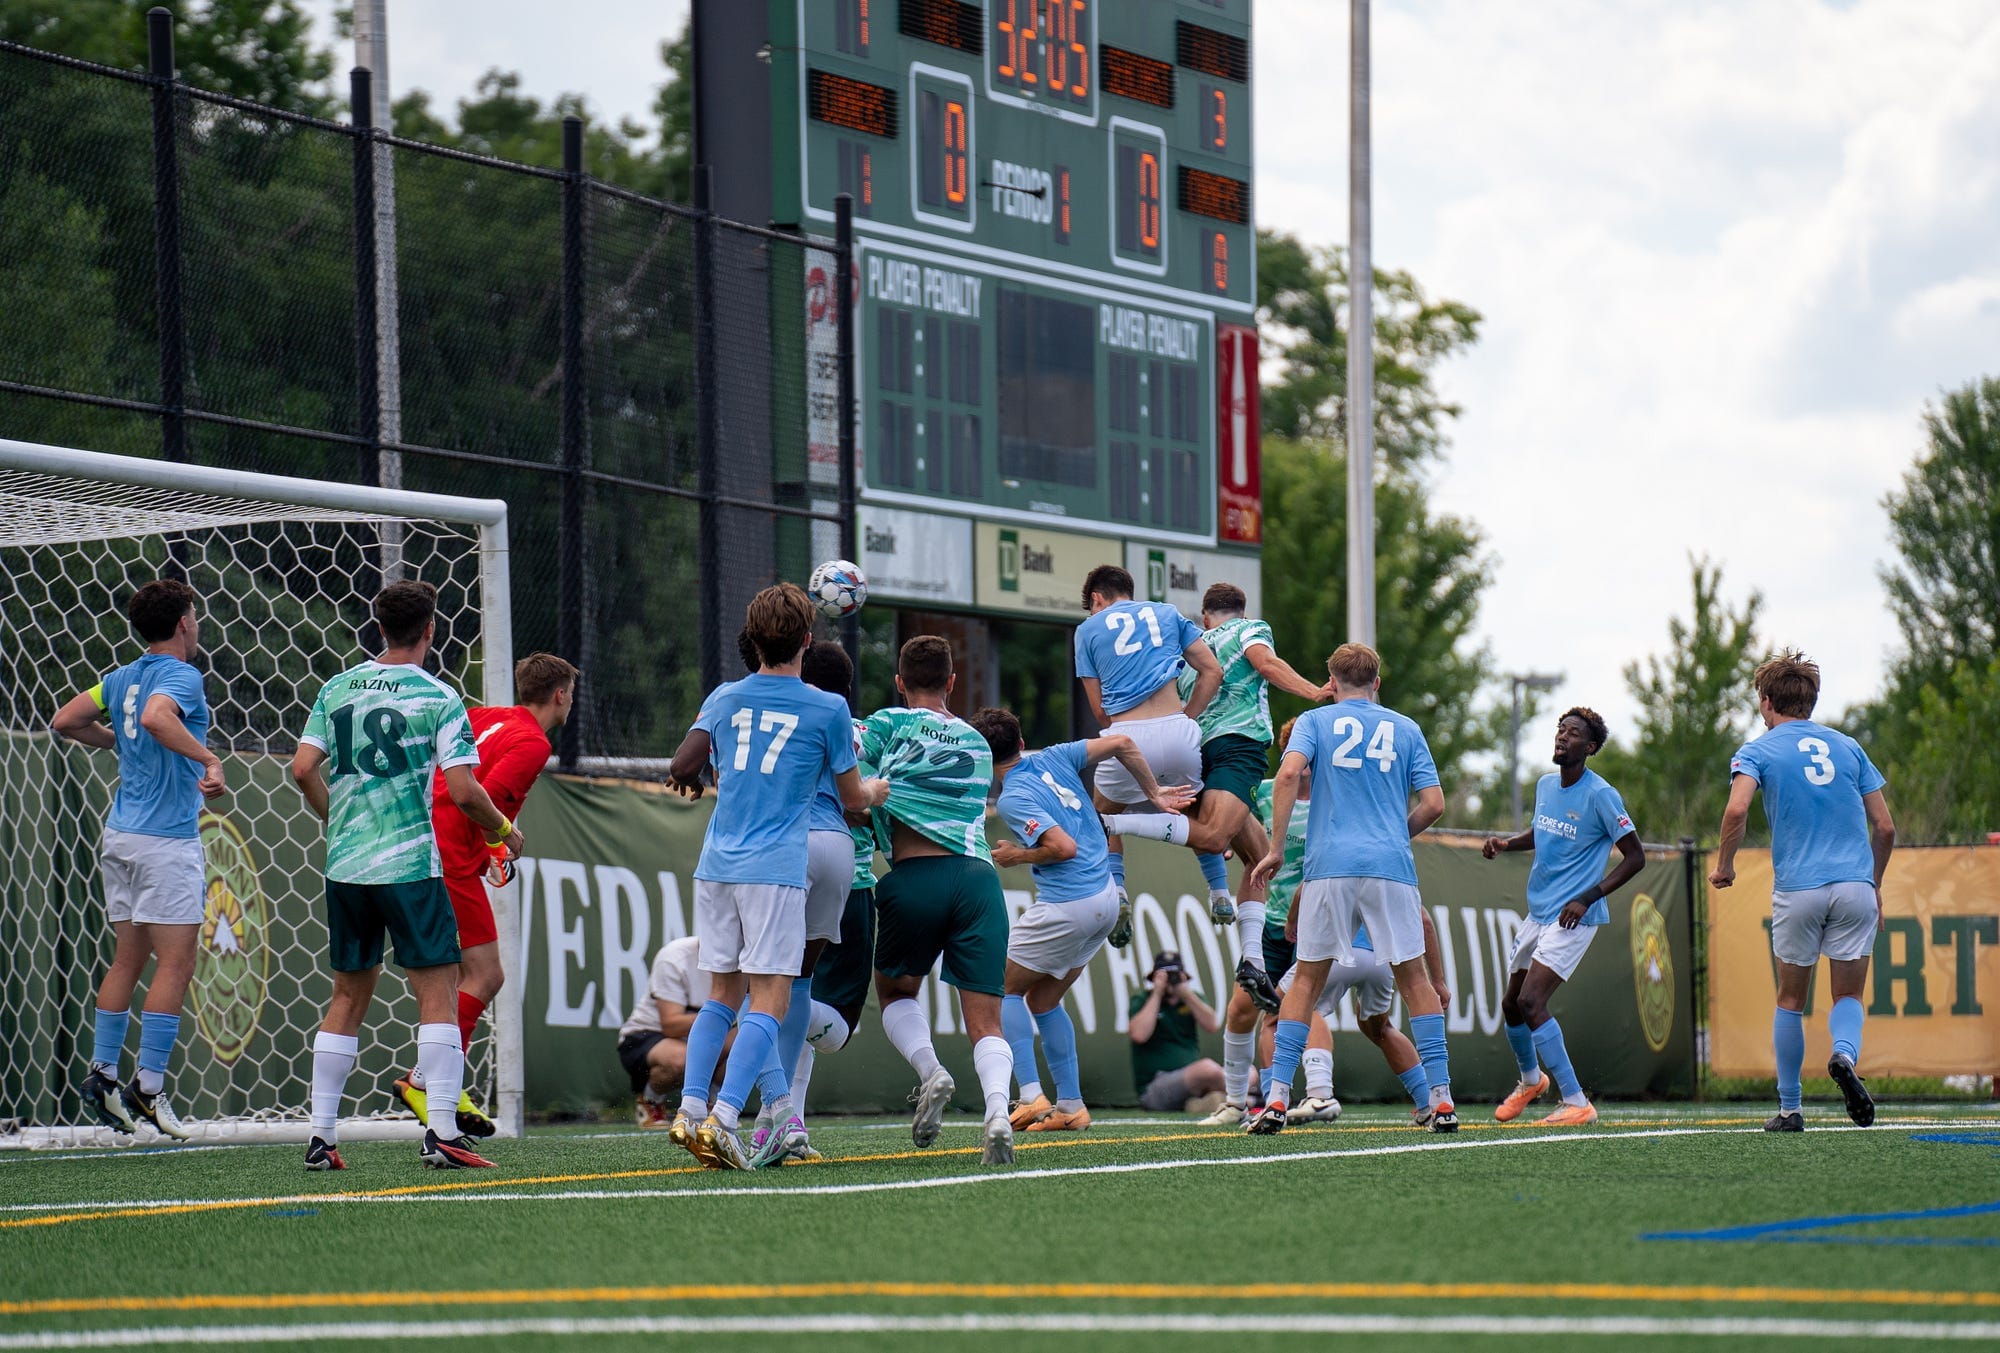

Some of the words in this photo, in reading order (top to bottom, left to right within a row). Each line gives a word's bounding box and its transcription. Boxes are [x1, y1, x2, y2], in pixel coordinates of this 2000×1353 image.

[1213, 90, 1226, 147] 3
[863, 153, 871, 204] 1
[944, 102, 966, 203] 0
[992, 159, 1053, 224] PERIOD
[1061, 171, 1071, 234] 1
[1139, 152, 1159, 248] 0
[868, 255, 921, 307] PLAYER
[923, 267, 982, 318] PENALTY
[1100, 303, 1147, 352] PLAYER
[1147, 313, 1199, 362] PENALTY
[865, 525, 896, 554] Bank
[1023, 543, 1054, 574] Bank
[1169, 562, 1198, 592] Bank
[1105, 606, 1163, 656] 21
[348, 679, 400, 693] BAZINI
[330, 703, 408, 778] 18
[731, 707, 799, 774] 17
[920, 725, 960, 746] RODRI
[1332, 716, 1397, 773] 24
[1797, 737, 1836, 786] 3
